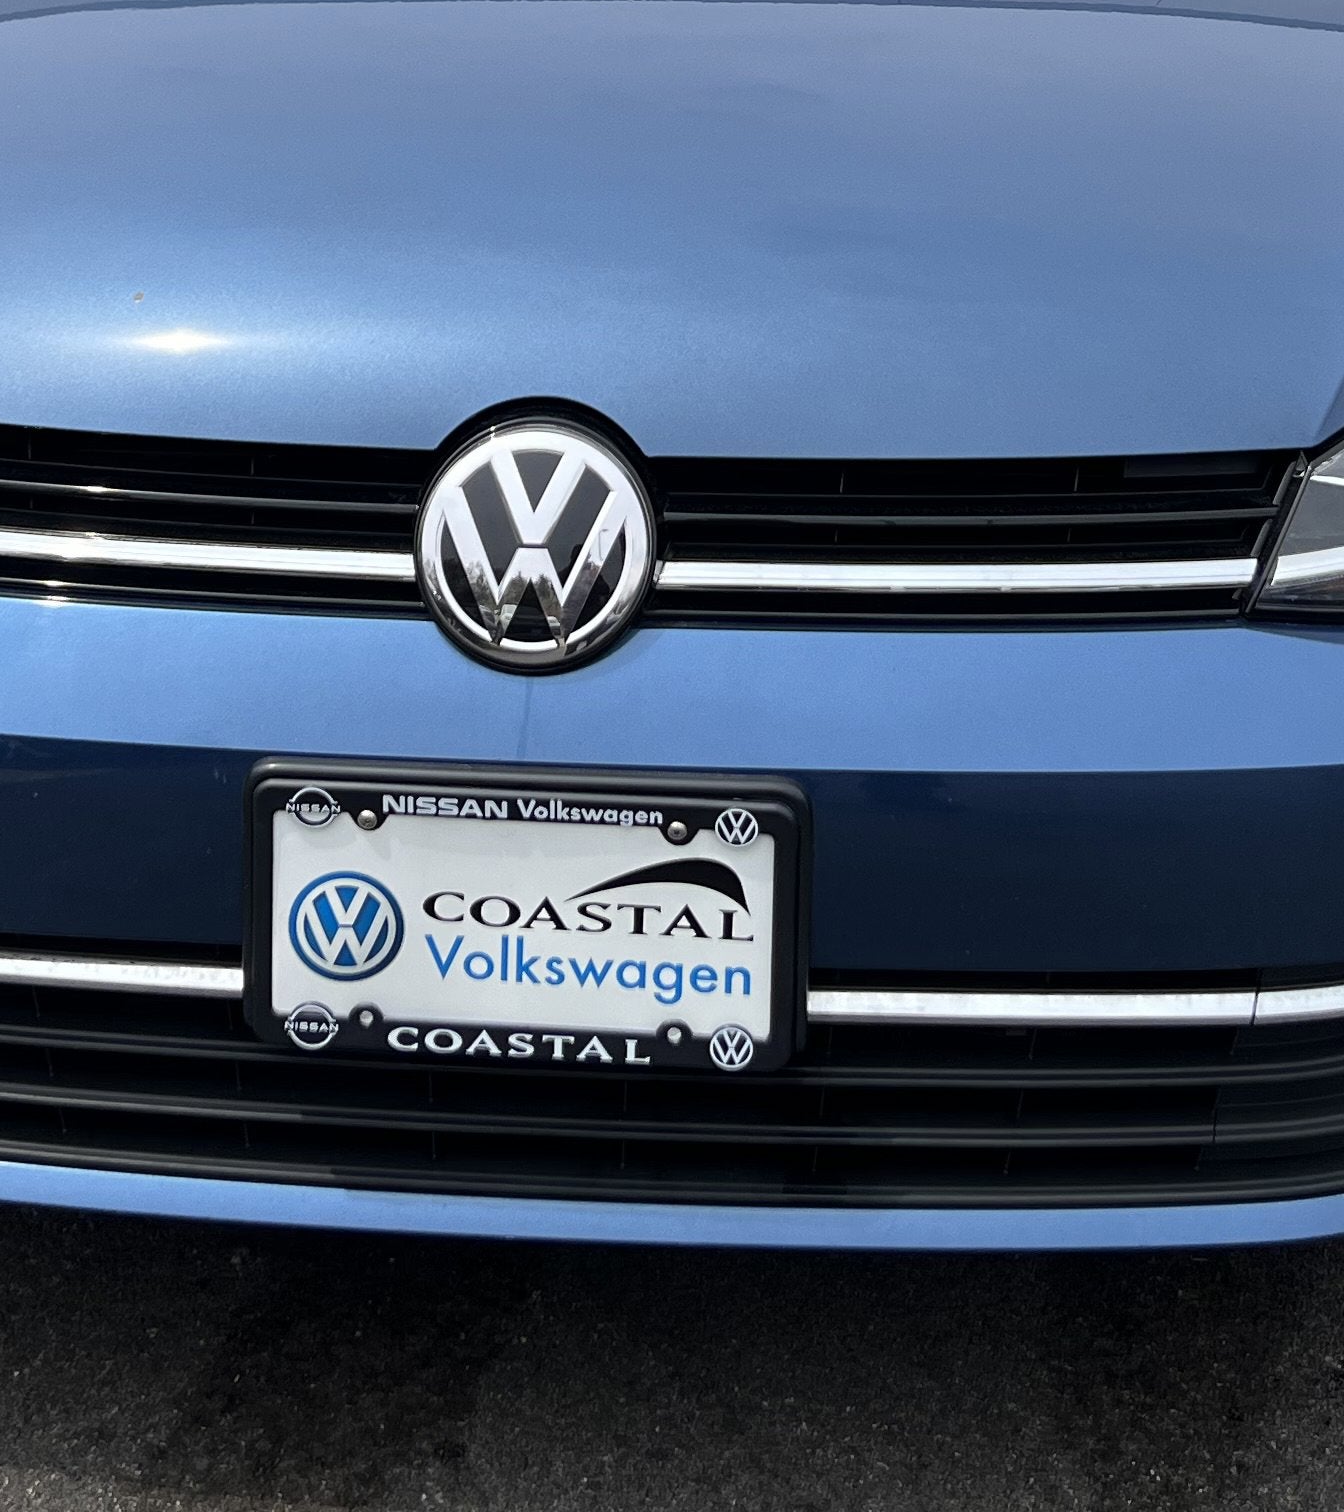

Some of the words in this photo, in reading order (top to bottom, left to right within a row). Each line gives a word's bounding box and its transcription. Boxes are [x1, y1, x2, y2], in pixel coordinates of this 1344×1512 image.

[285, 802, 342, 814] NISSAN
[382, 794, 508, 819] NISSAN
[517, 798, 663, 827] Volkswagen
[422, 890, 754, 942] COASTAL
[424, 934, 751, 1005] Volkswagen
[284, 1020, 339, 1033] NISSAN
[387, 1026, 651, 1066] COASTAL
